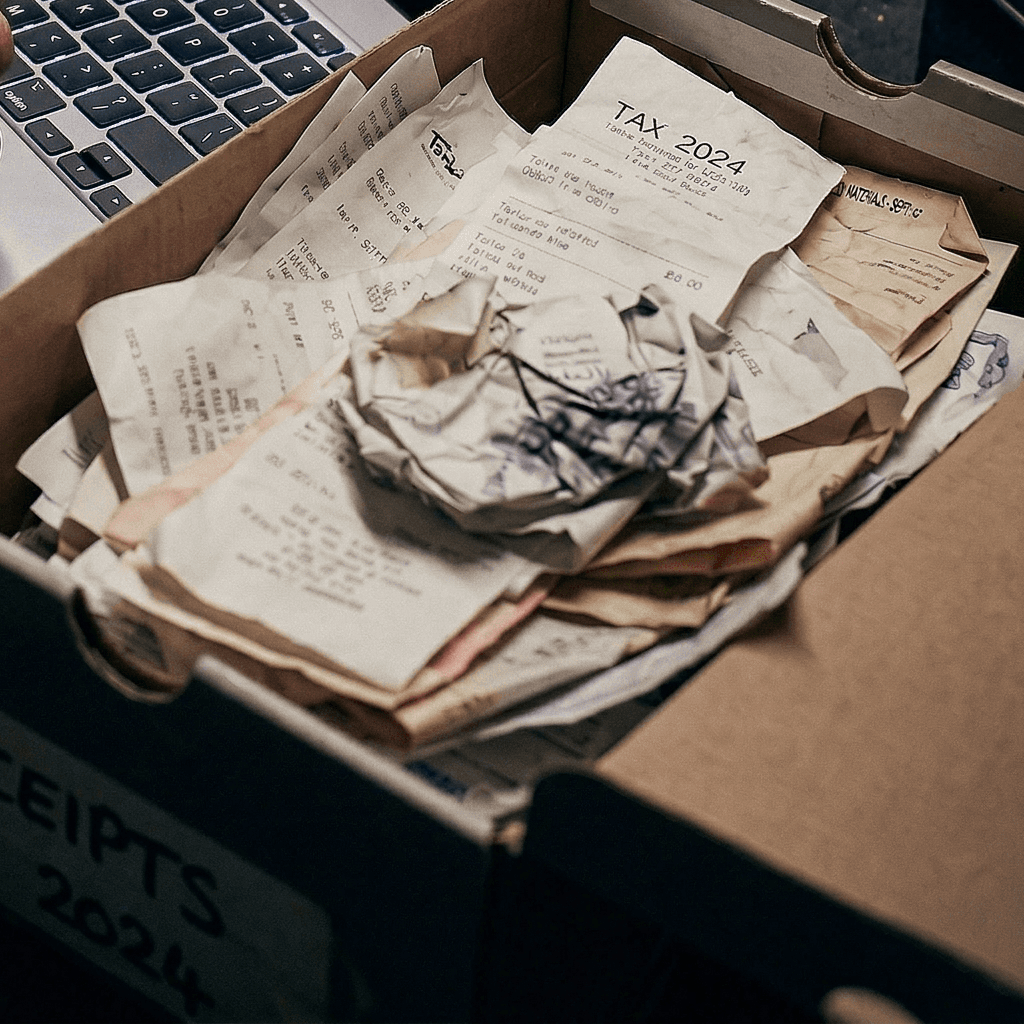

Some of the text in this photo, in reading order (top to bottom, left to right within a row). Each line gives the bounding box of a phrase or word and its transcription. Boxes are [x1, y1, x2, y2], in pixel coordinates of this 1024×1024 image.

[614, 100, 668, 140] TAX
[674, 134, 747, 176] 2024
[38, 864, 216, 1016] 2024
